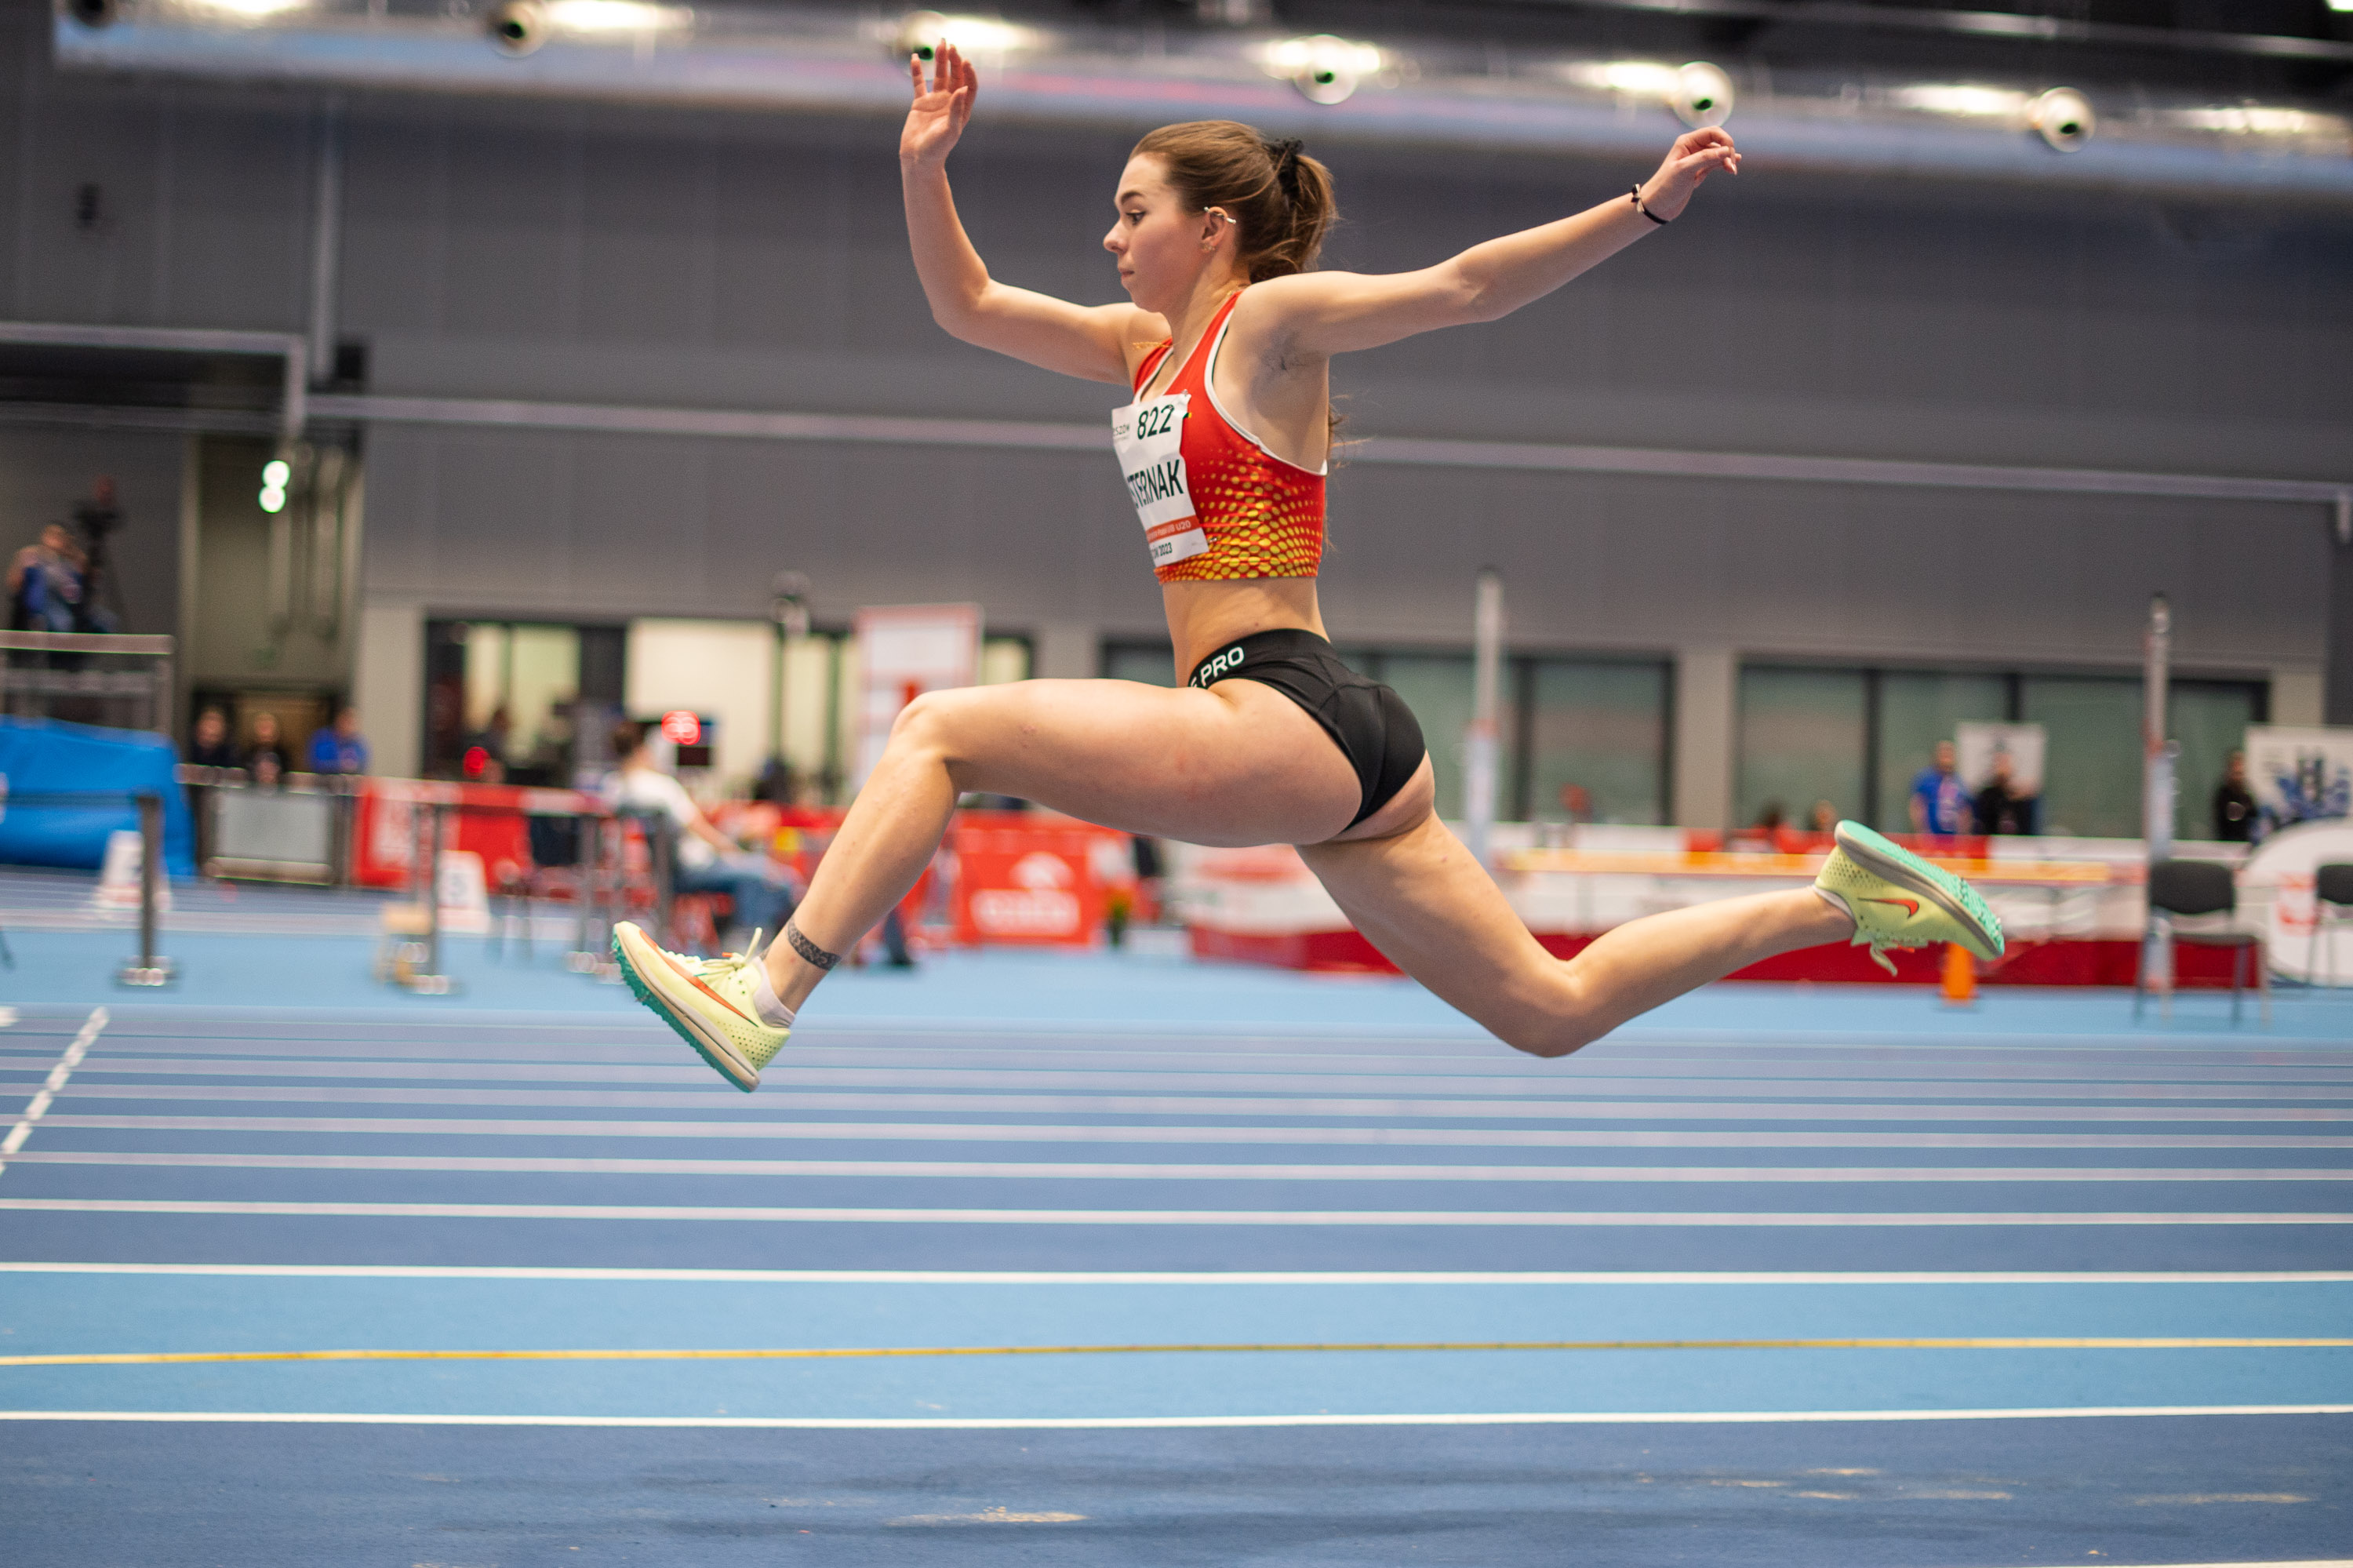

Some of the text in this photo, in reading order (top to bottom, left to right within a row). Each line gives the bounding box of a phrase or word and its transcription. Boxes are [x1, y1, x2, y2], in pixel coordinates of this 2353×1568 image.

[1137, 404, 1175, 440] 822
[1176, 520, 1191, 531] U20
[1158, 542, 1173, 556] 2023
[1200, 646, 1244, 687] PRO
